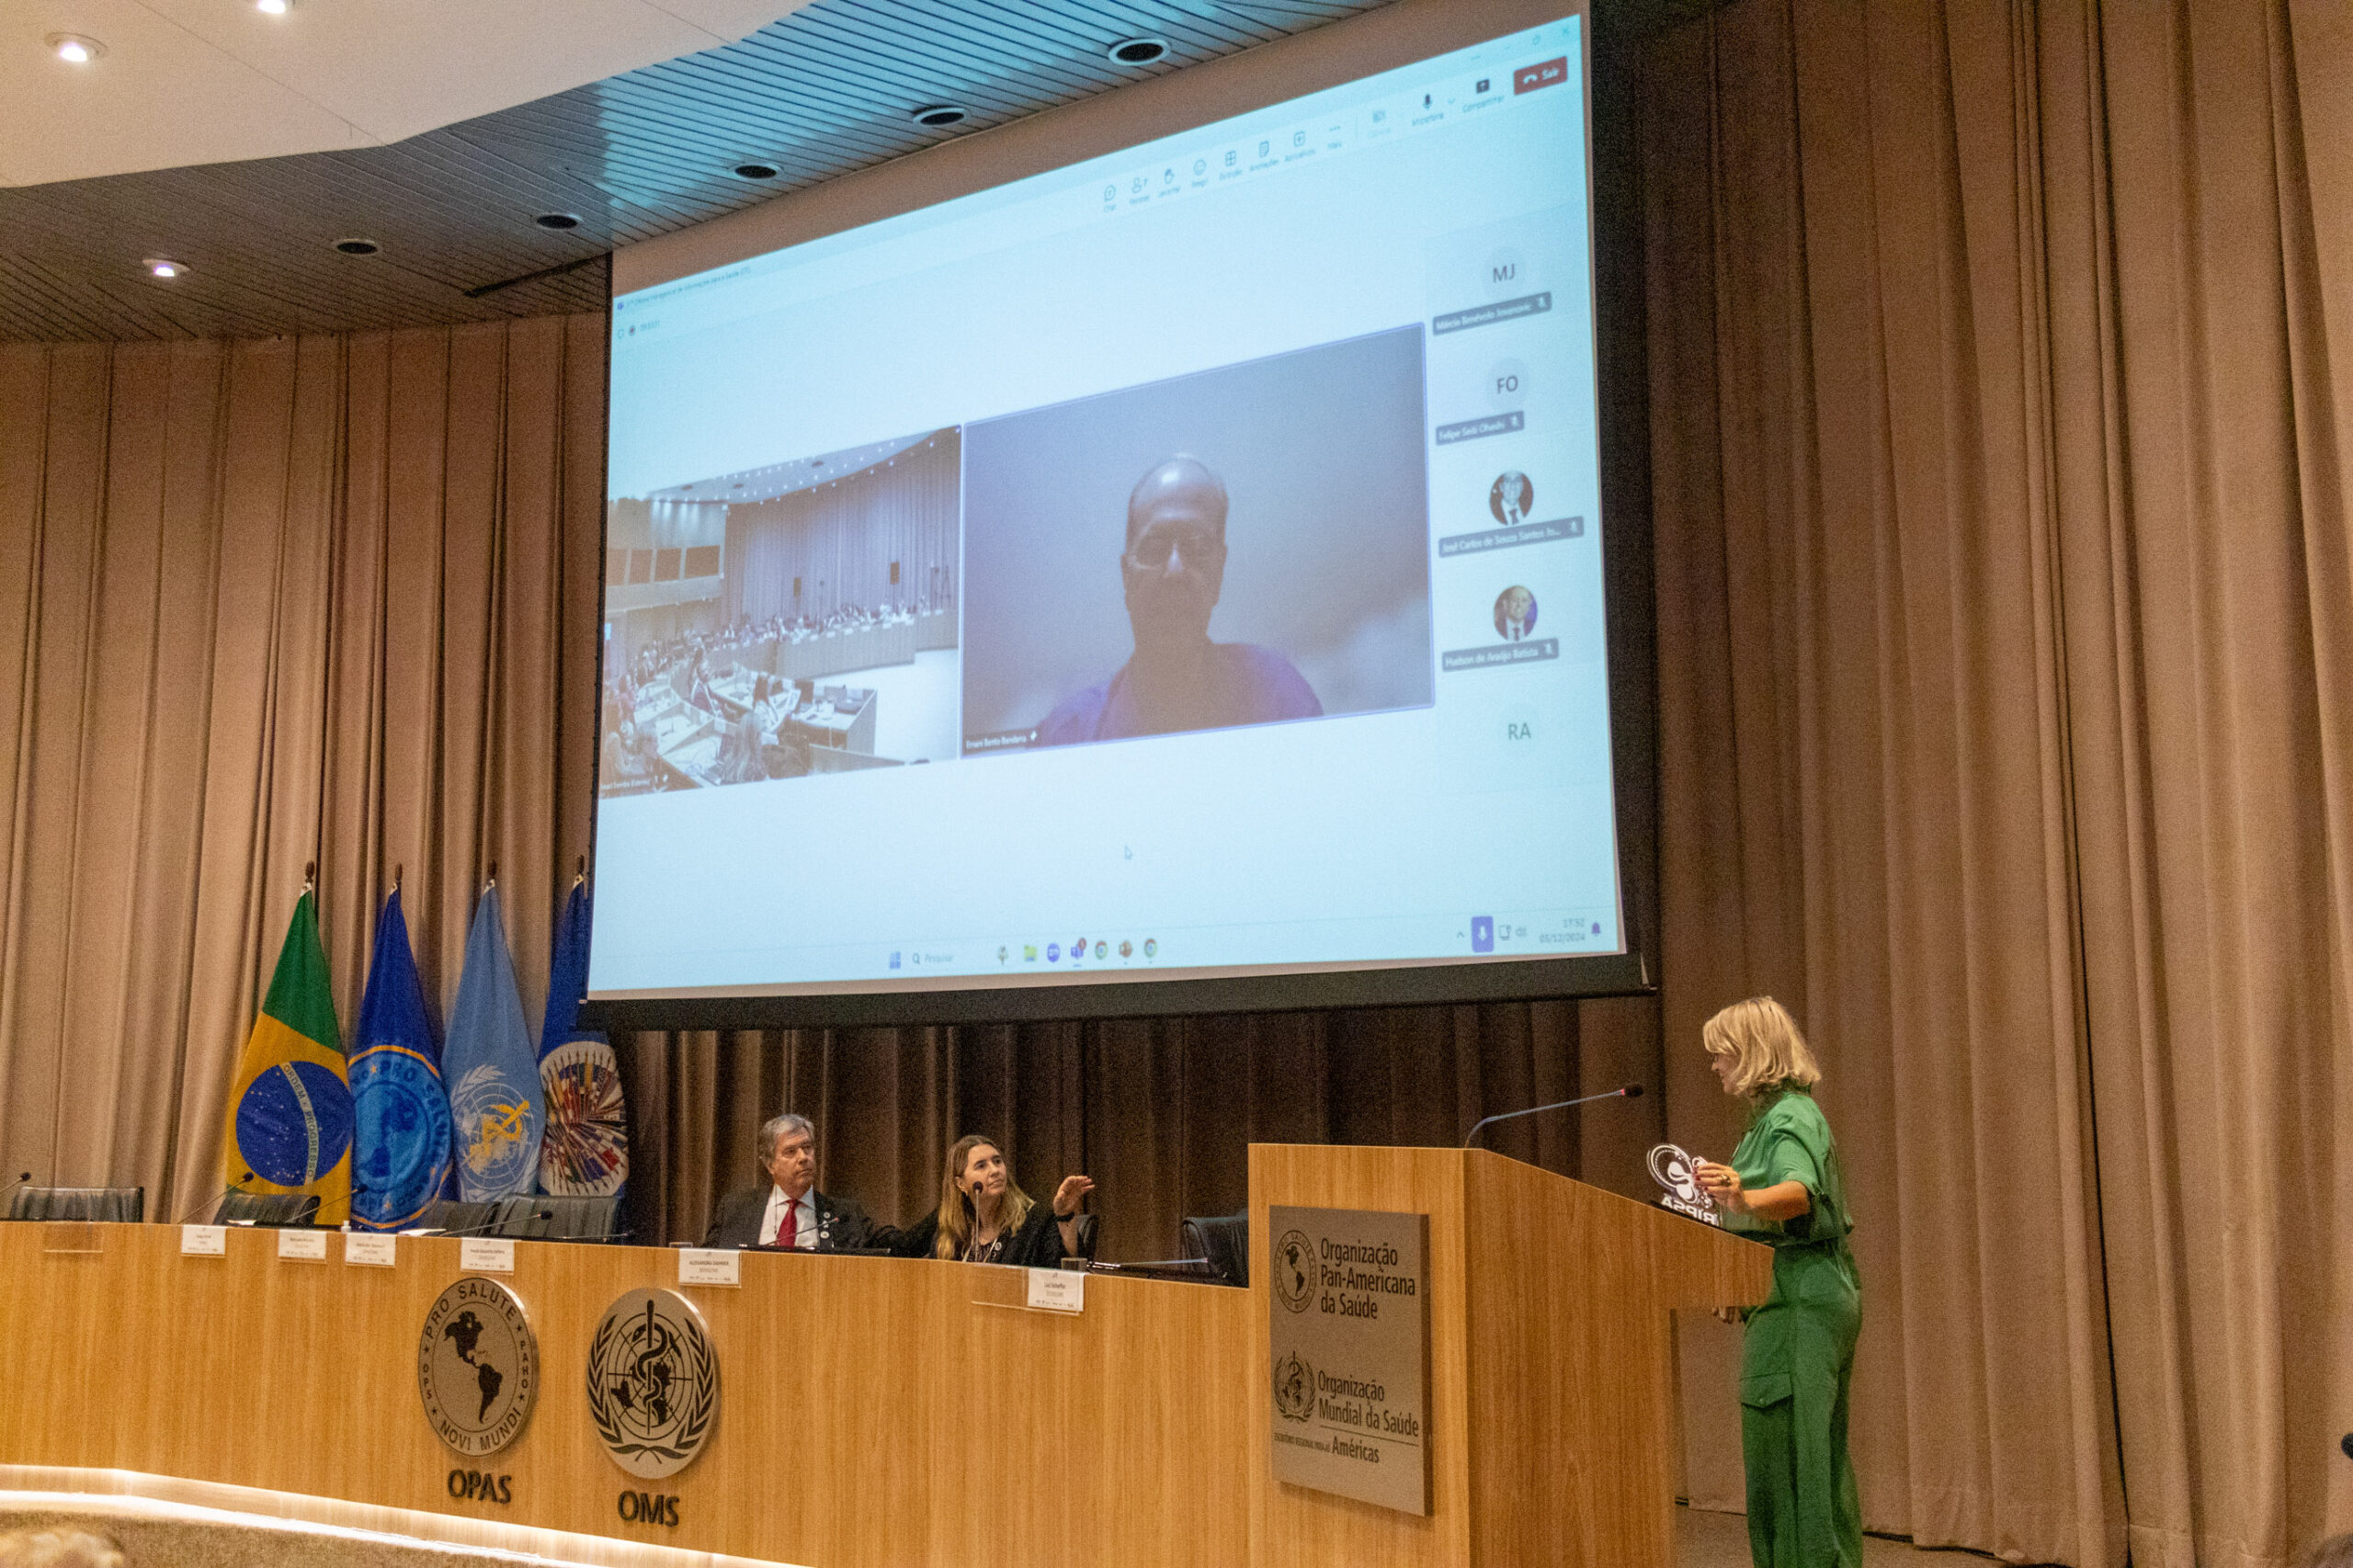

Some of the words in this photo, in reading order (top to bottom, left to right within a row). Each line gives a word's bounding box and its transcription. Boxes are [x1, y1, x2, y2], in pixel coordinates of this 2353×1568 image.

[1493, 263, 1516, 283] MJ
[1495, 375, 1518, 394] FO
[1475, 653, 1485, 663] de
[1508, 722, 1532, 741] RA
[283, 1064, 307, 1100] ORDEM
[304, 1110, 319, 1177] PROGRESSO
[1321, 1237, 1398, 1271] Organização
[1321, 1264, 1416, 1297] Pan-Americana
[426, 1298, 449, 1340] PRO
[458, 1283, 517, 1322] SALUTE
[1321, 1292, 1336, 1315] da
[1340, 1293, 1378, 1320] Saúde
[422, 1363, 432, 1400] OPS
[520, 1340, 529, 1390] PAHO
[1318, 1369, 1385, 1405] Organização
[440, 1419, 472, 1451] NOVI
[480, 1407, 522, 1451] MUNDI
[1319, 1397, 1362, 1427] Mundial
[1366, 1404, 1380, 1430] da
[1382, 1408, 1419, 1437] Saúde
[1332, 1436, 1380, 1464] Américas
[447, 1469, 512, 1505] OPAS
[618, 1489, 680, 1528] OMS
